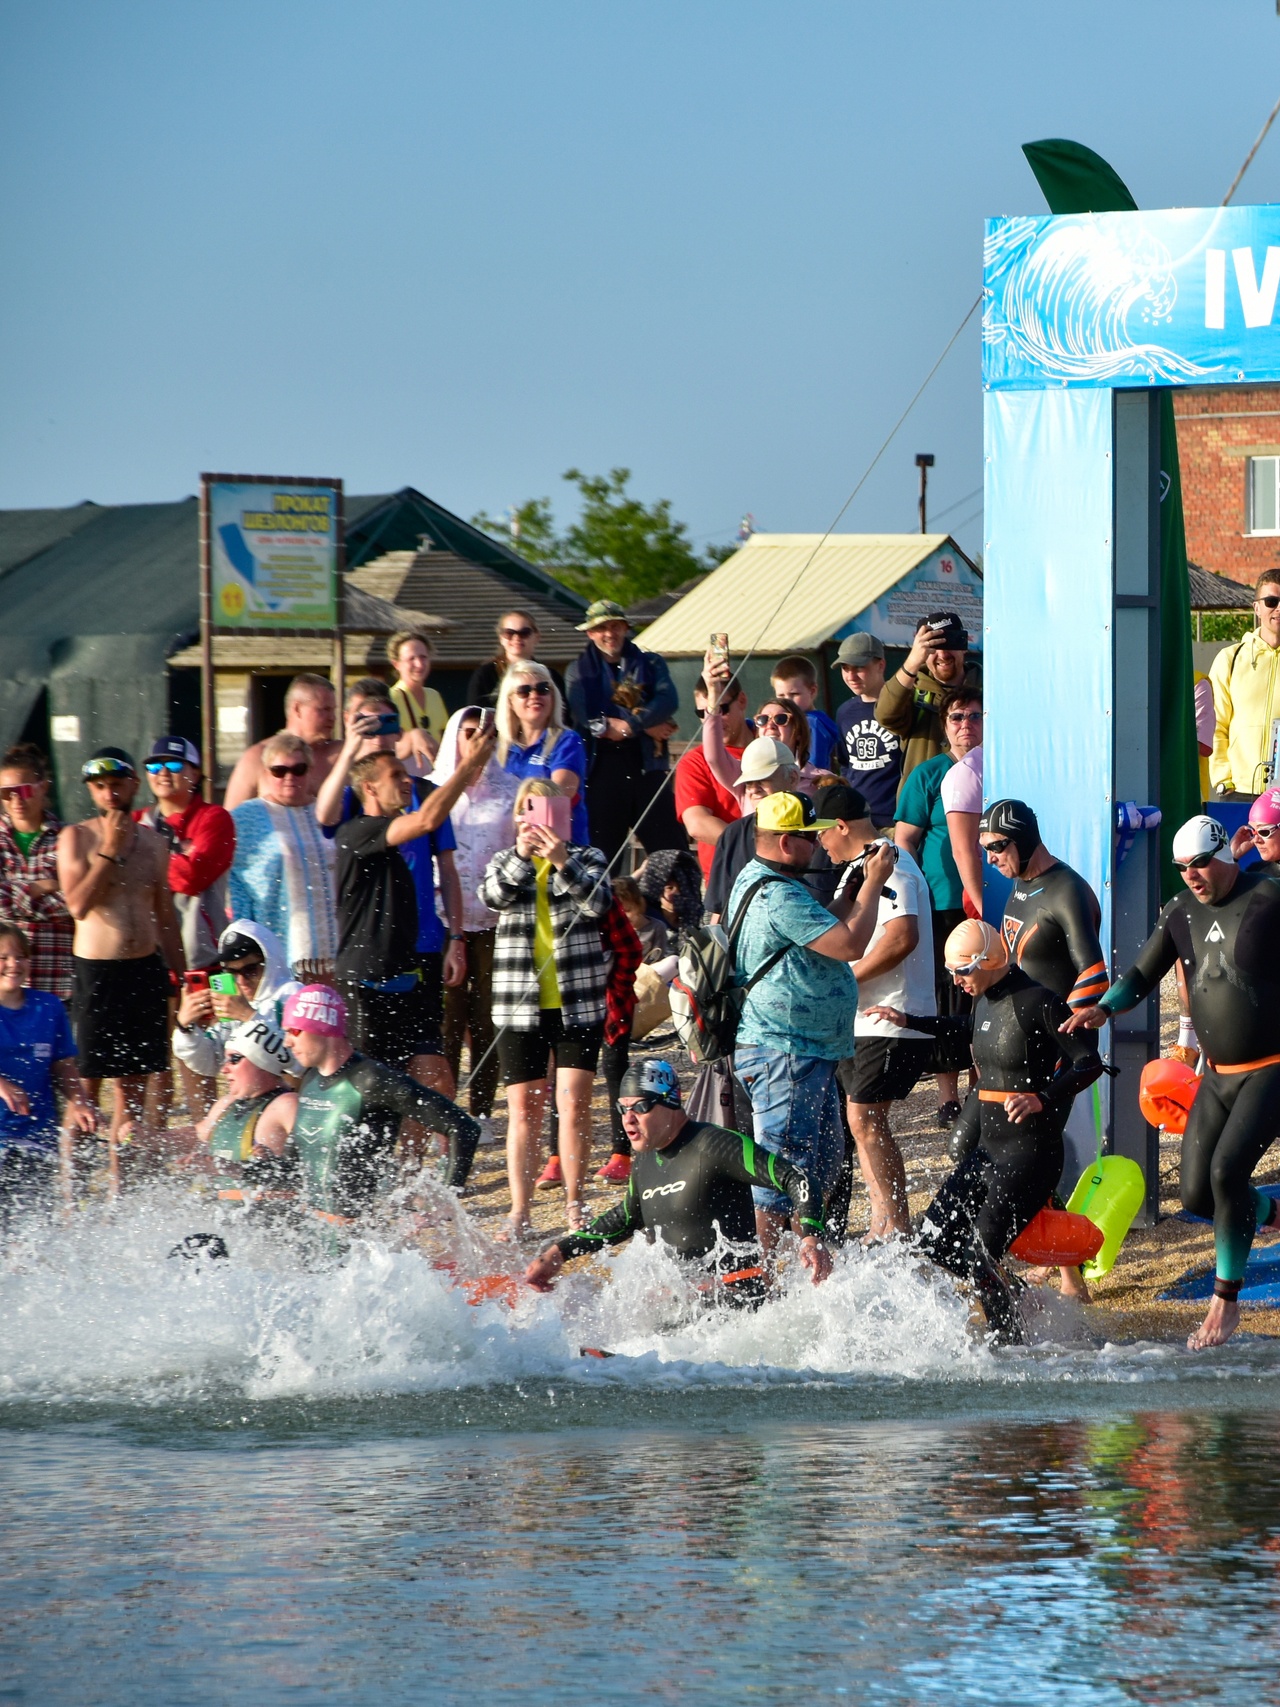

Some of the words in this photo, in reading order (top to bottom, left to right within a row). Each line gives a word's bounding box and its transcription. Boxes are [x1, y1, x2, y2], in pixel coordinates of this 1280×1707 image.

[941, 560, 952, 573] 16
[856, 737, 878, 759] 83
[291, 1002, 338, 1026] STAR
[245, 1023, 291, 1064] RUS
[642, 1180, 687, 1201] orca
